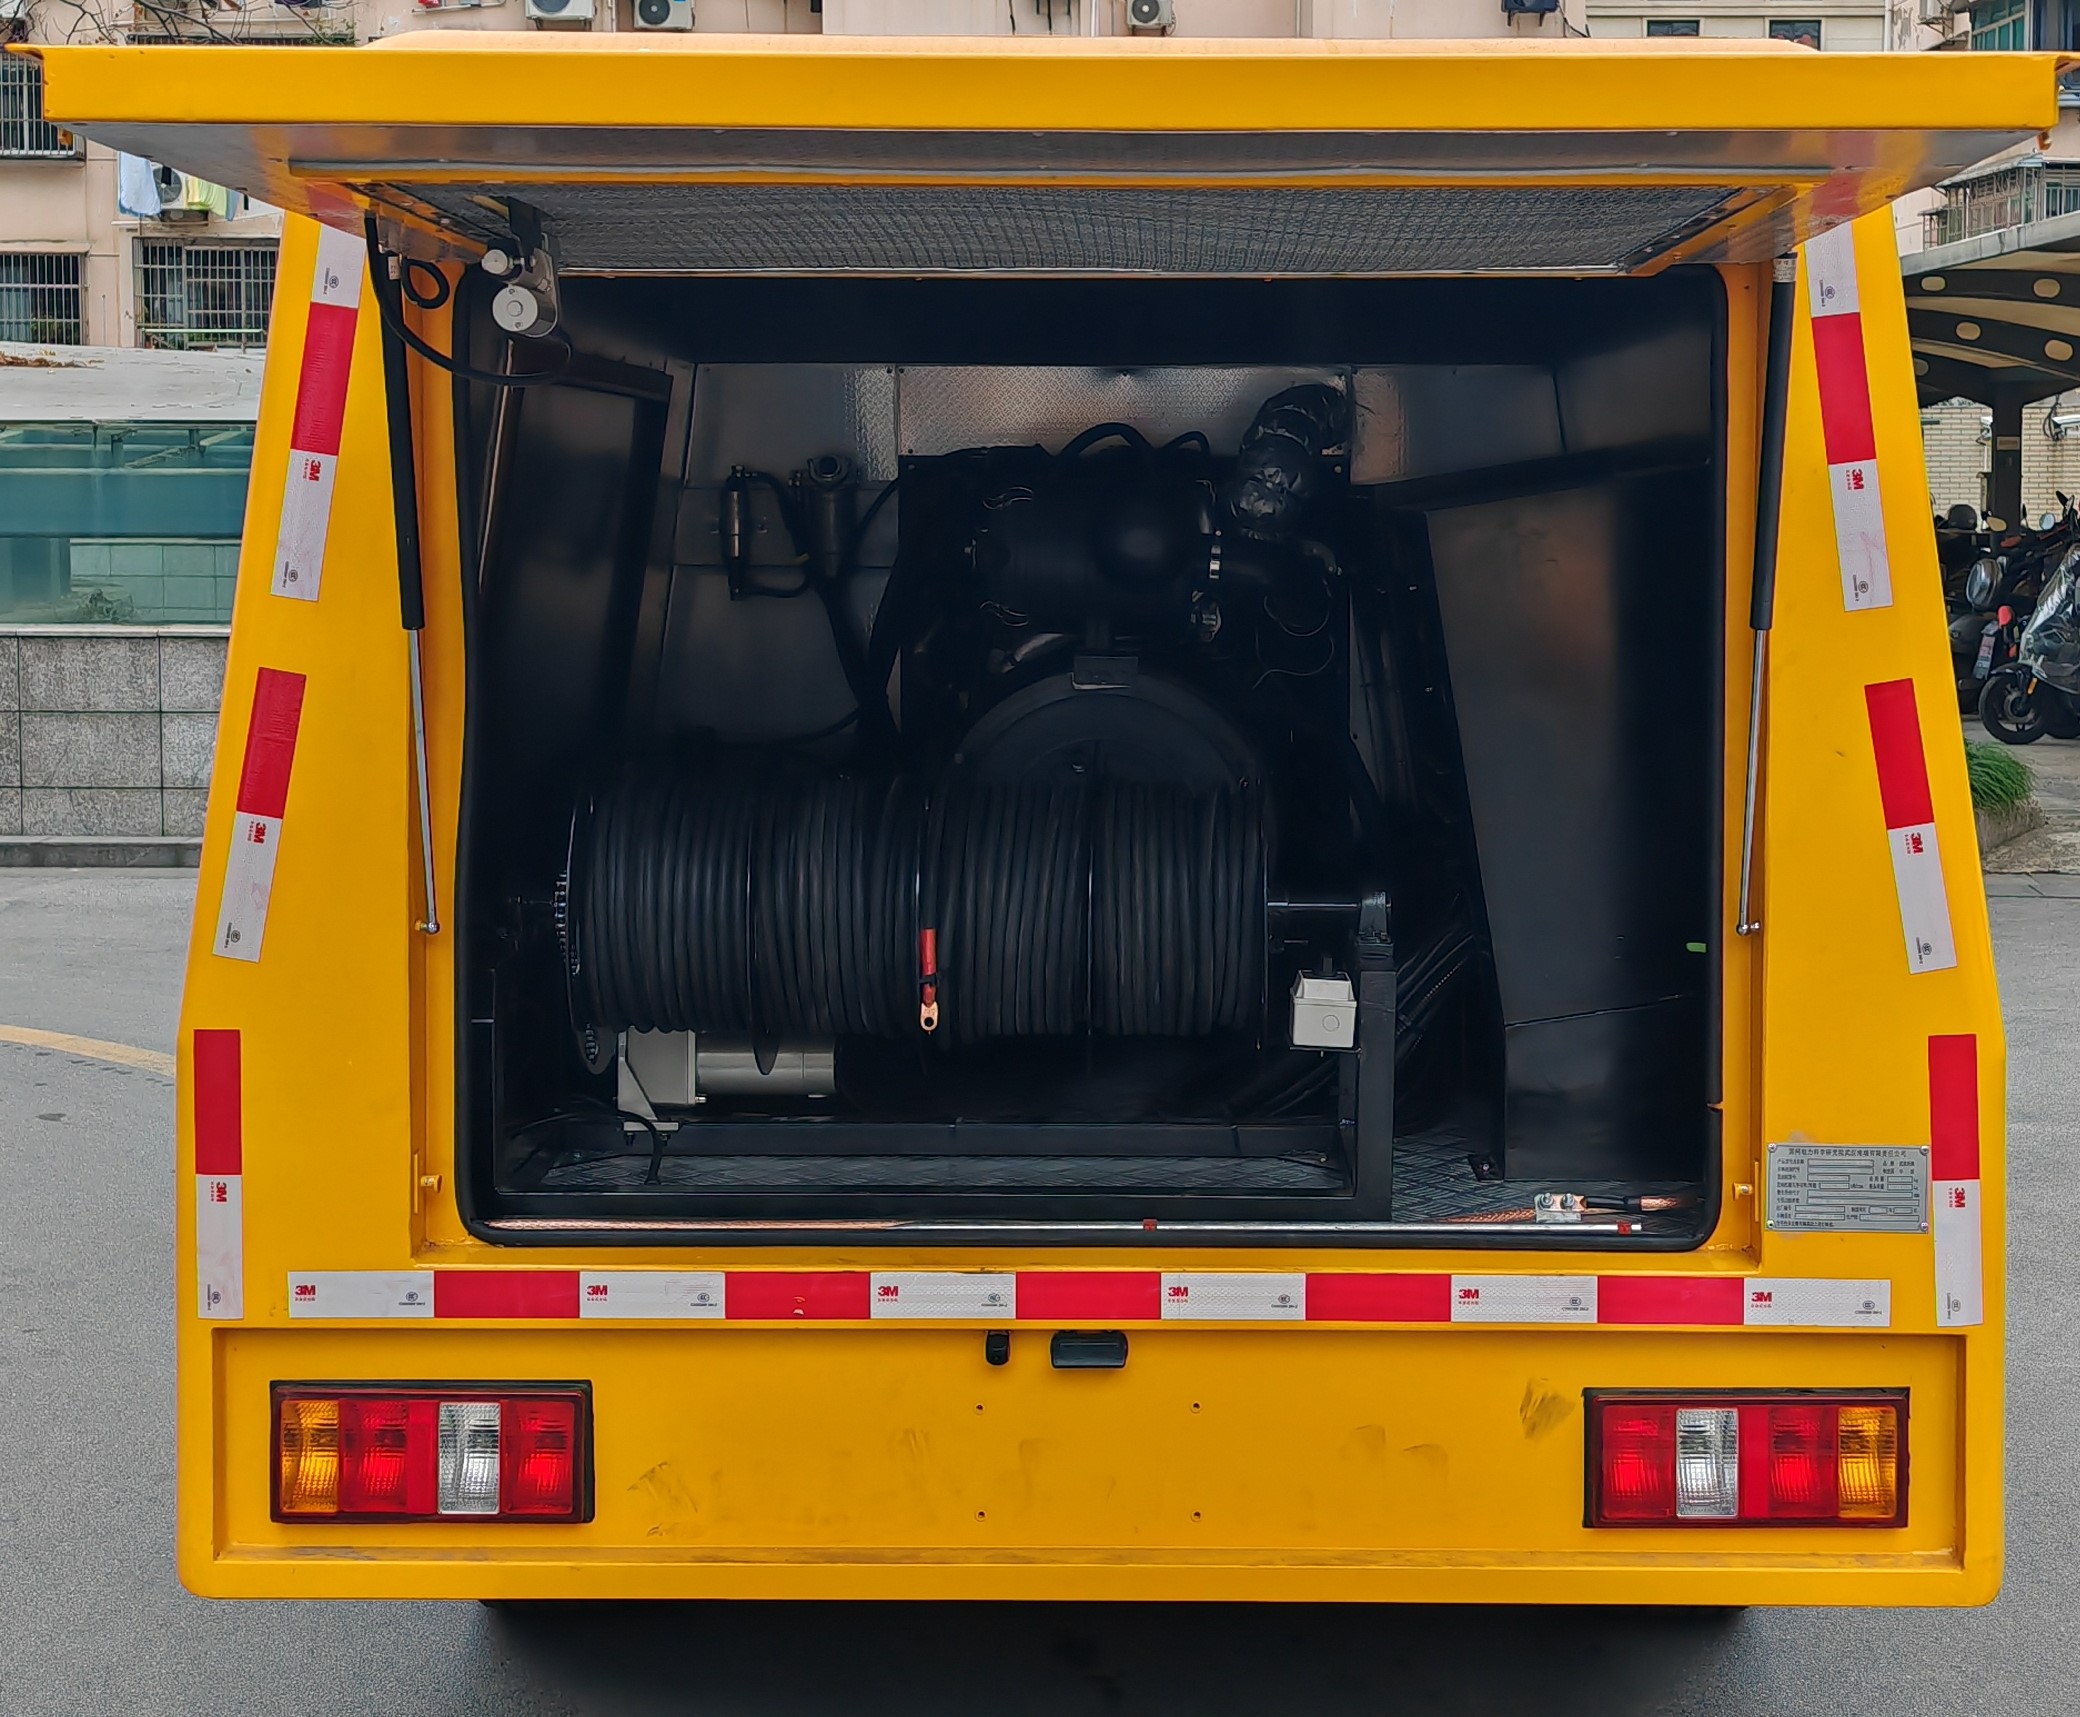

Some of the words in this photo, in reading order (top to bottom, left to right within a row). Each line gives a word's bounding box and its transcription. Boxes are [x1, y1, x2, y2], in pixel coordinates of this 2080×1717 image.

[308, 459, 321, 481] 3M
[1852, 469, 1863, 490] 3M
[253, 822, 266, 843] 3M
[1910, 832, 1922, 854] 3M
[216, 1182, 227, 1203] 3M
[1954, 1187, 1965, 1208] 3M
[295, 1285, 316, 1296] 3M
[587, 1285, 608, 1296] 3M
[878, 1286, 899, 1297] 3M
[1168, 1286, 1189, 1297] 3M
[1458, 1289, 1479, 1299] 3M
[1752, 1292, 1773, 1303] 3M
